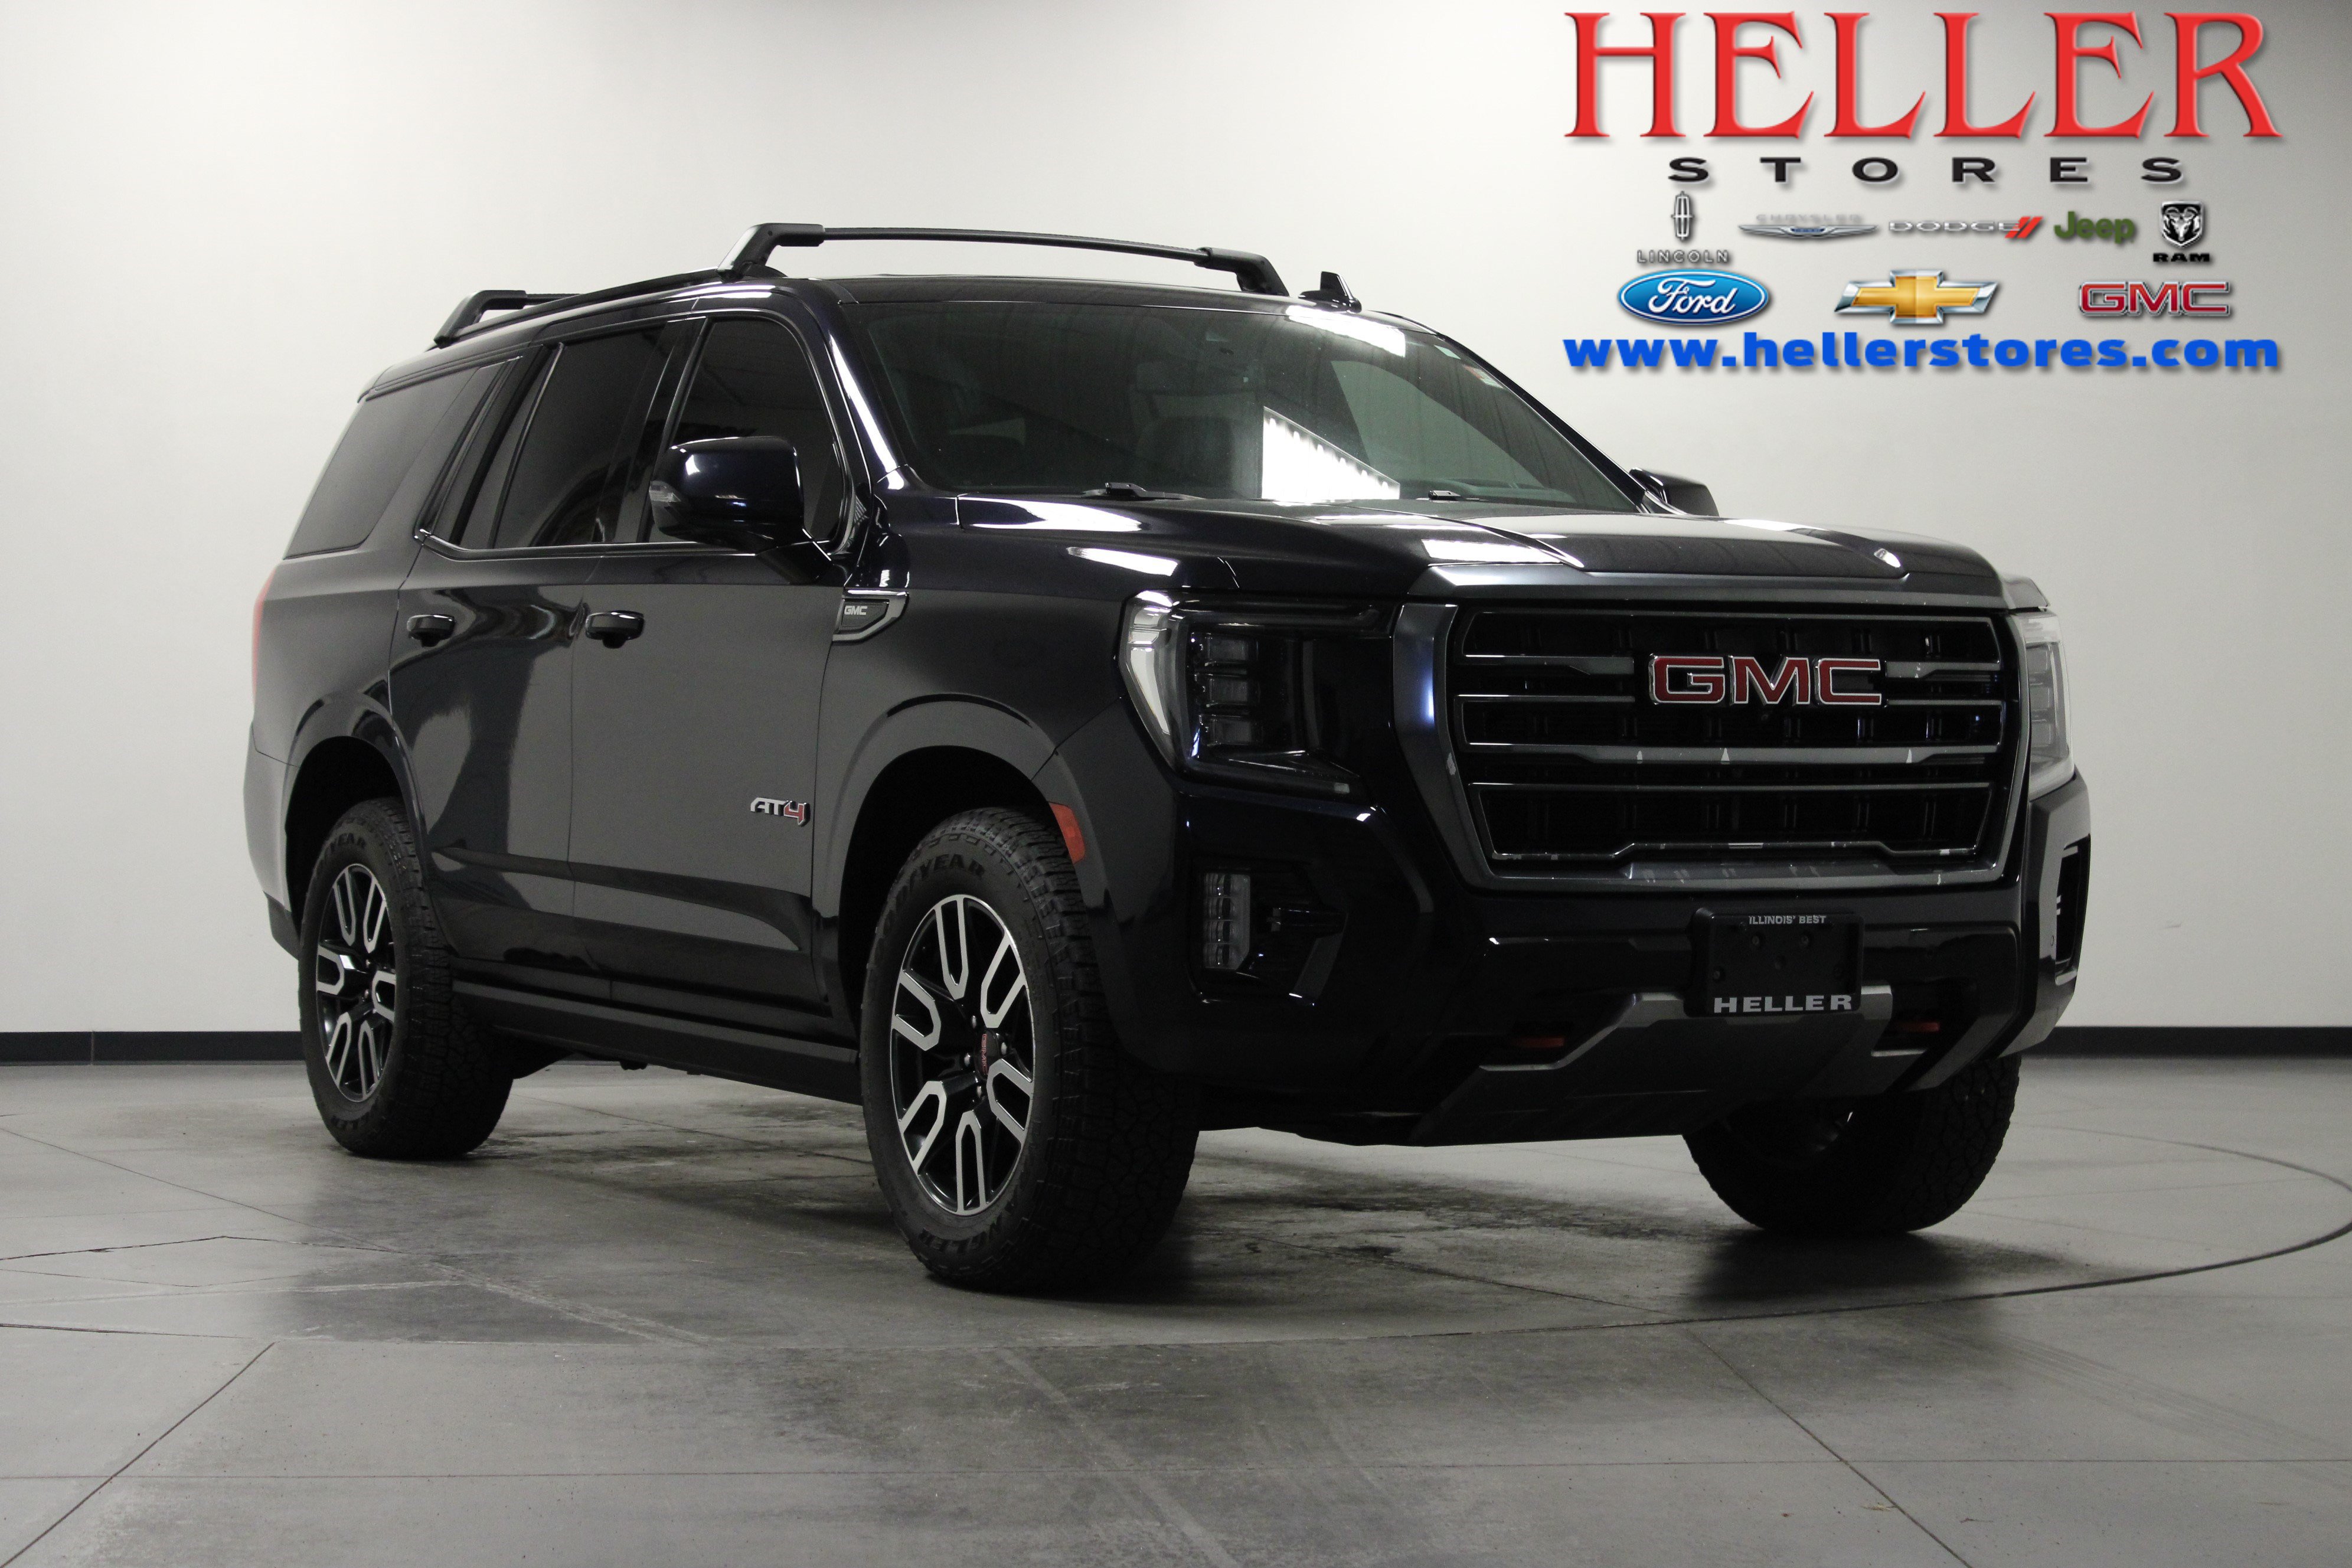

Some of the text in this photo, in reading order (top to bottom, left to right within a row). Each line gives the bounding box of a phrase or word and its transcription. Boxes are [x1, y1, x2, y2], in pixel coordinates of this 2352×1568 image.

[844, 605, 868, 616] GMC
[1649, 654, 1883, 705] GMC
[750, 796, 810, 827] AT4
[1799, 915, 1827, 924] BEST
[1713, 994, 1853, 1014] HELLER
